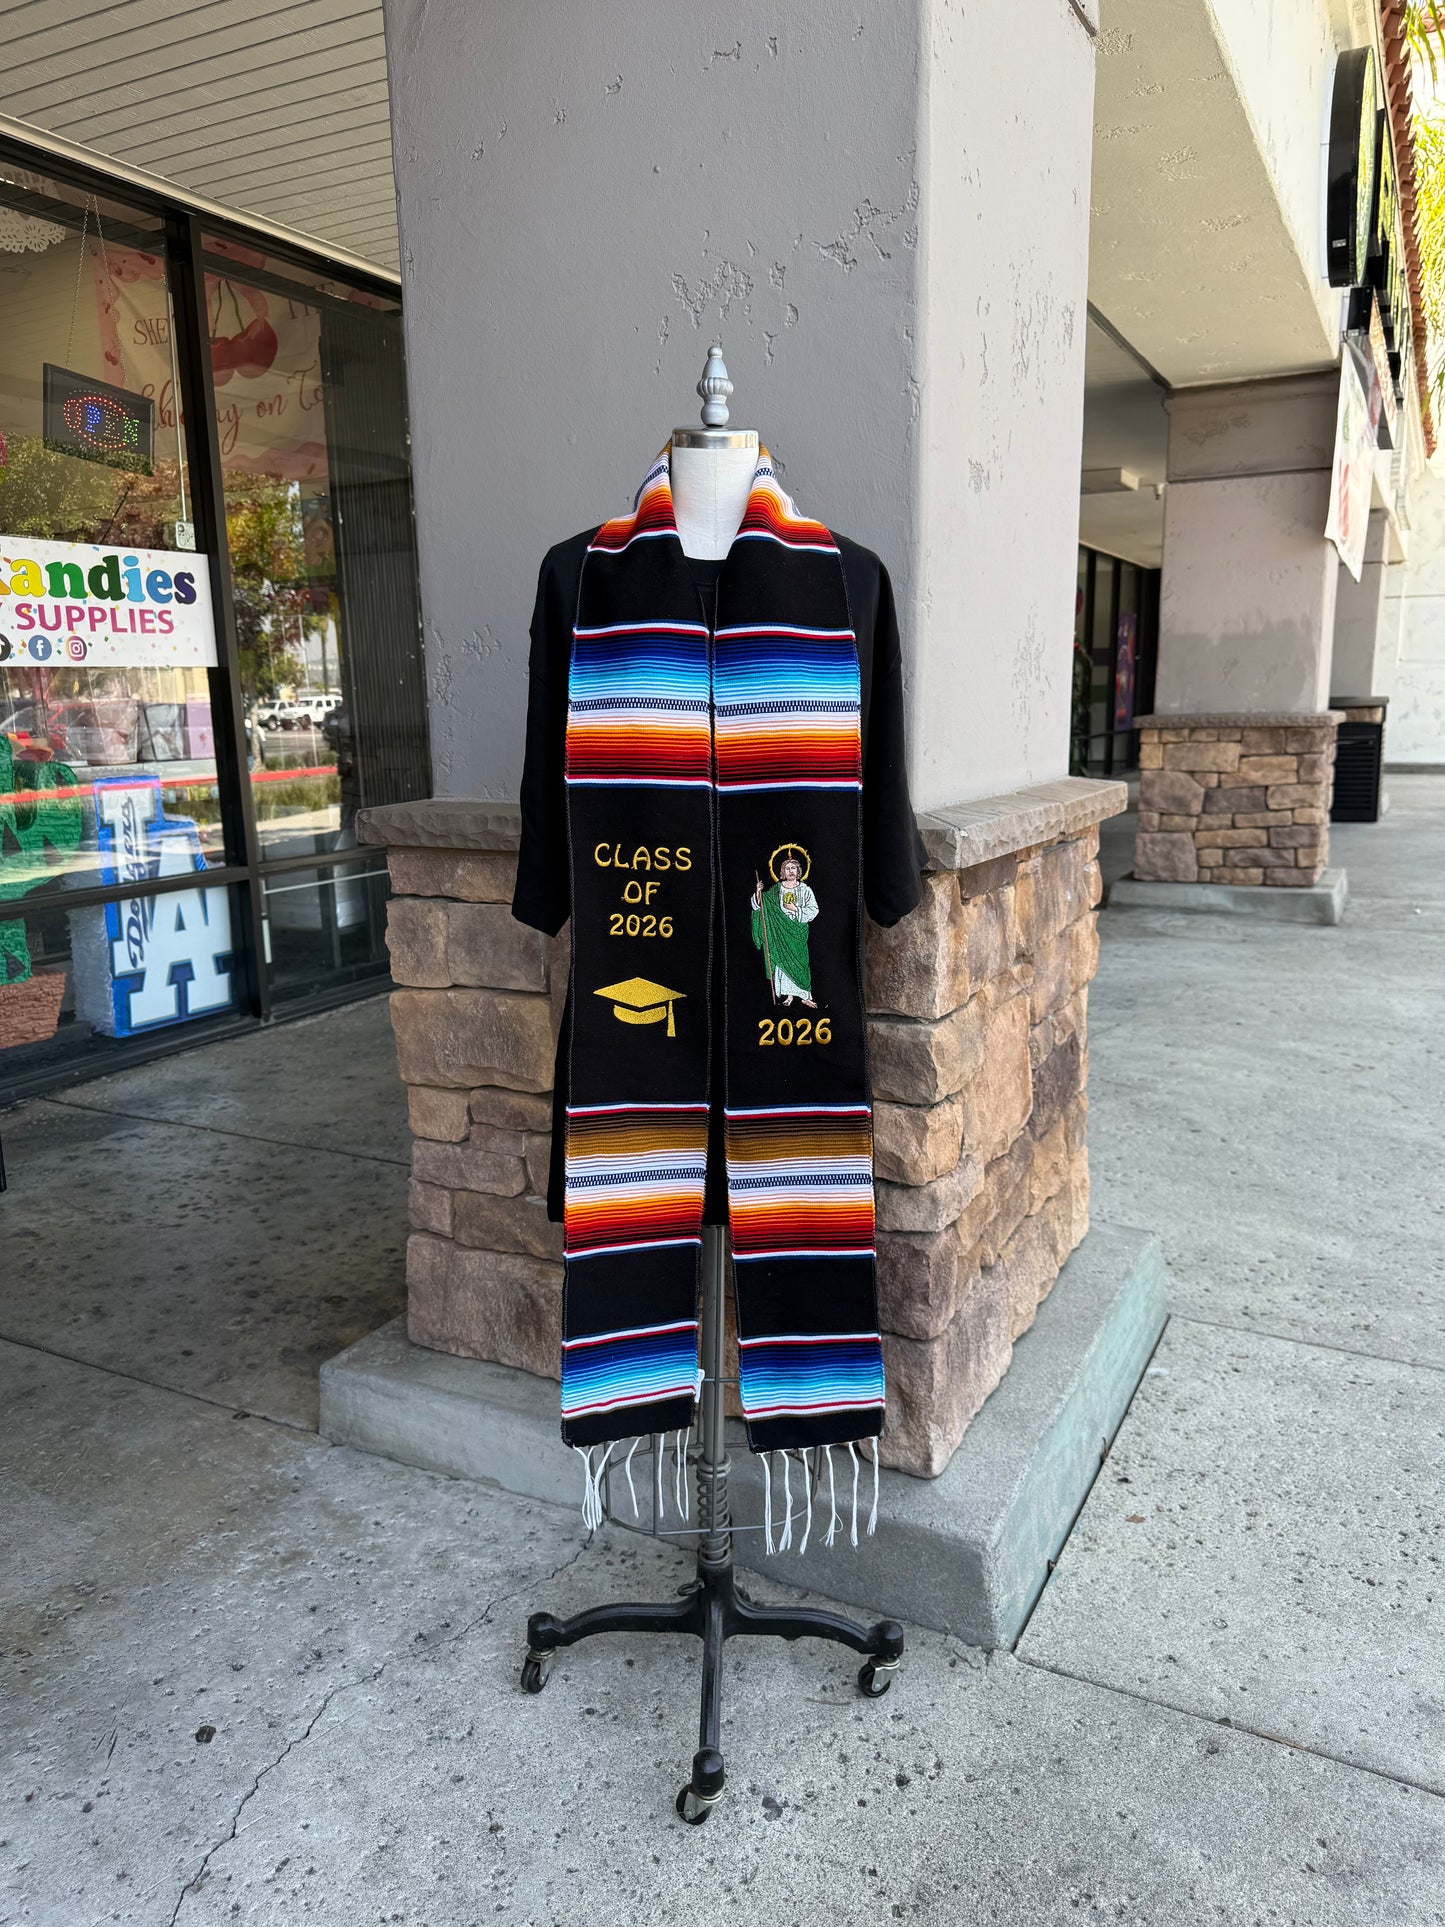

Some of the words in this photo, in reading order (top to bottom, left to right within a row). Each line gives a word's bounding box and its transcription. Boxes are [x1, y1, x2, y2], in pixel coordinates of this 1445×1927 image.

[256, 394, 287, 418] on
[64, 399, 139, 445] OPEN
[15, 603, 175, 635] SUPPLIES
[594, 843, 692, 871] CLASS
[623, 881, 661, 905] OF
[609, 913, 674, 938] 2026
[758, 1018, 832, 1046] 2026
